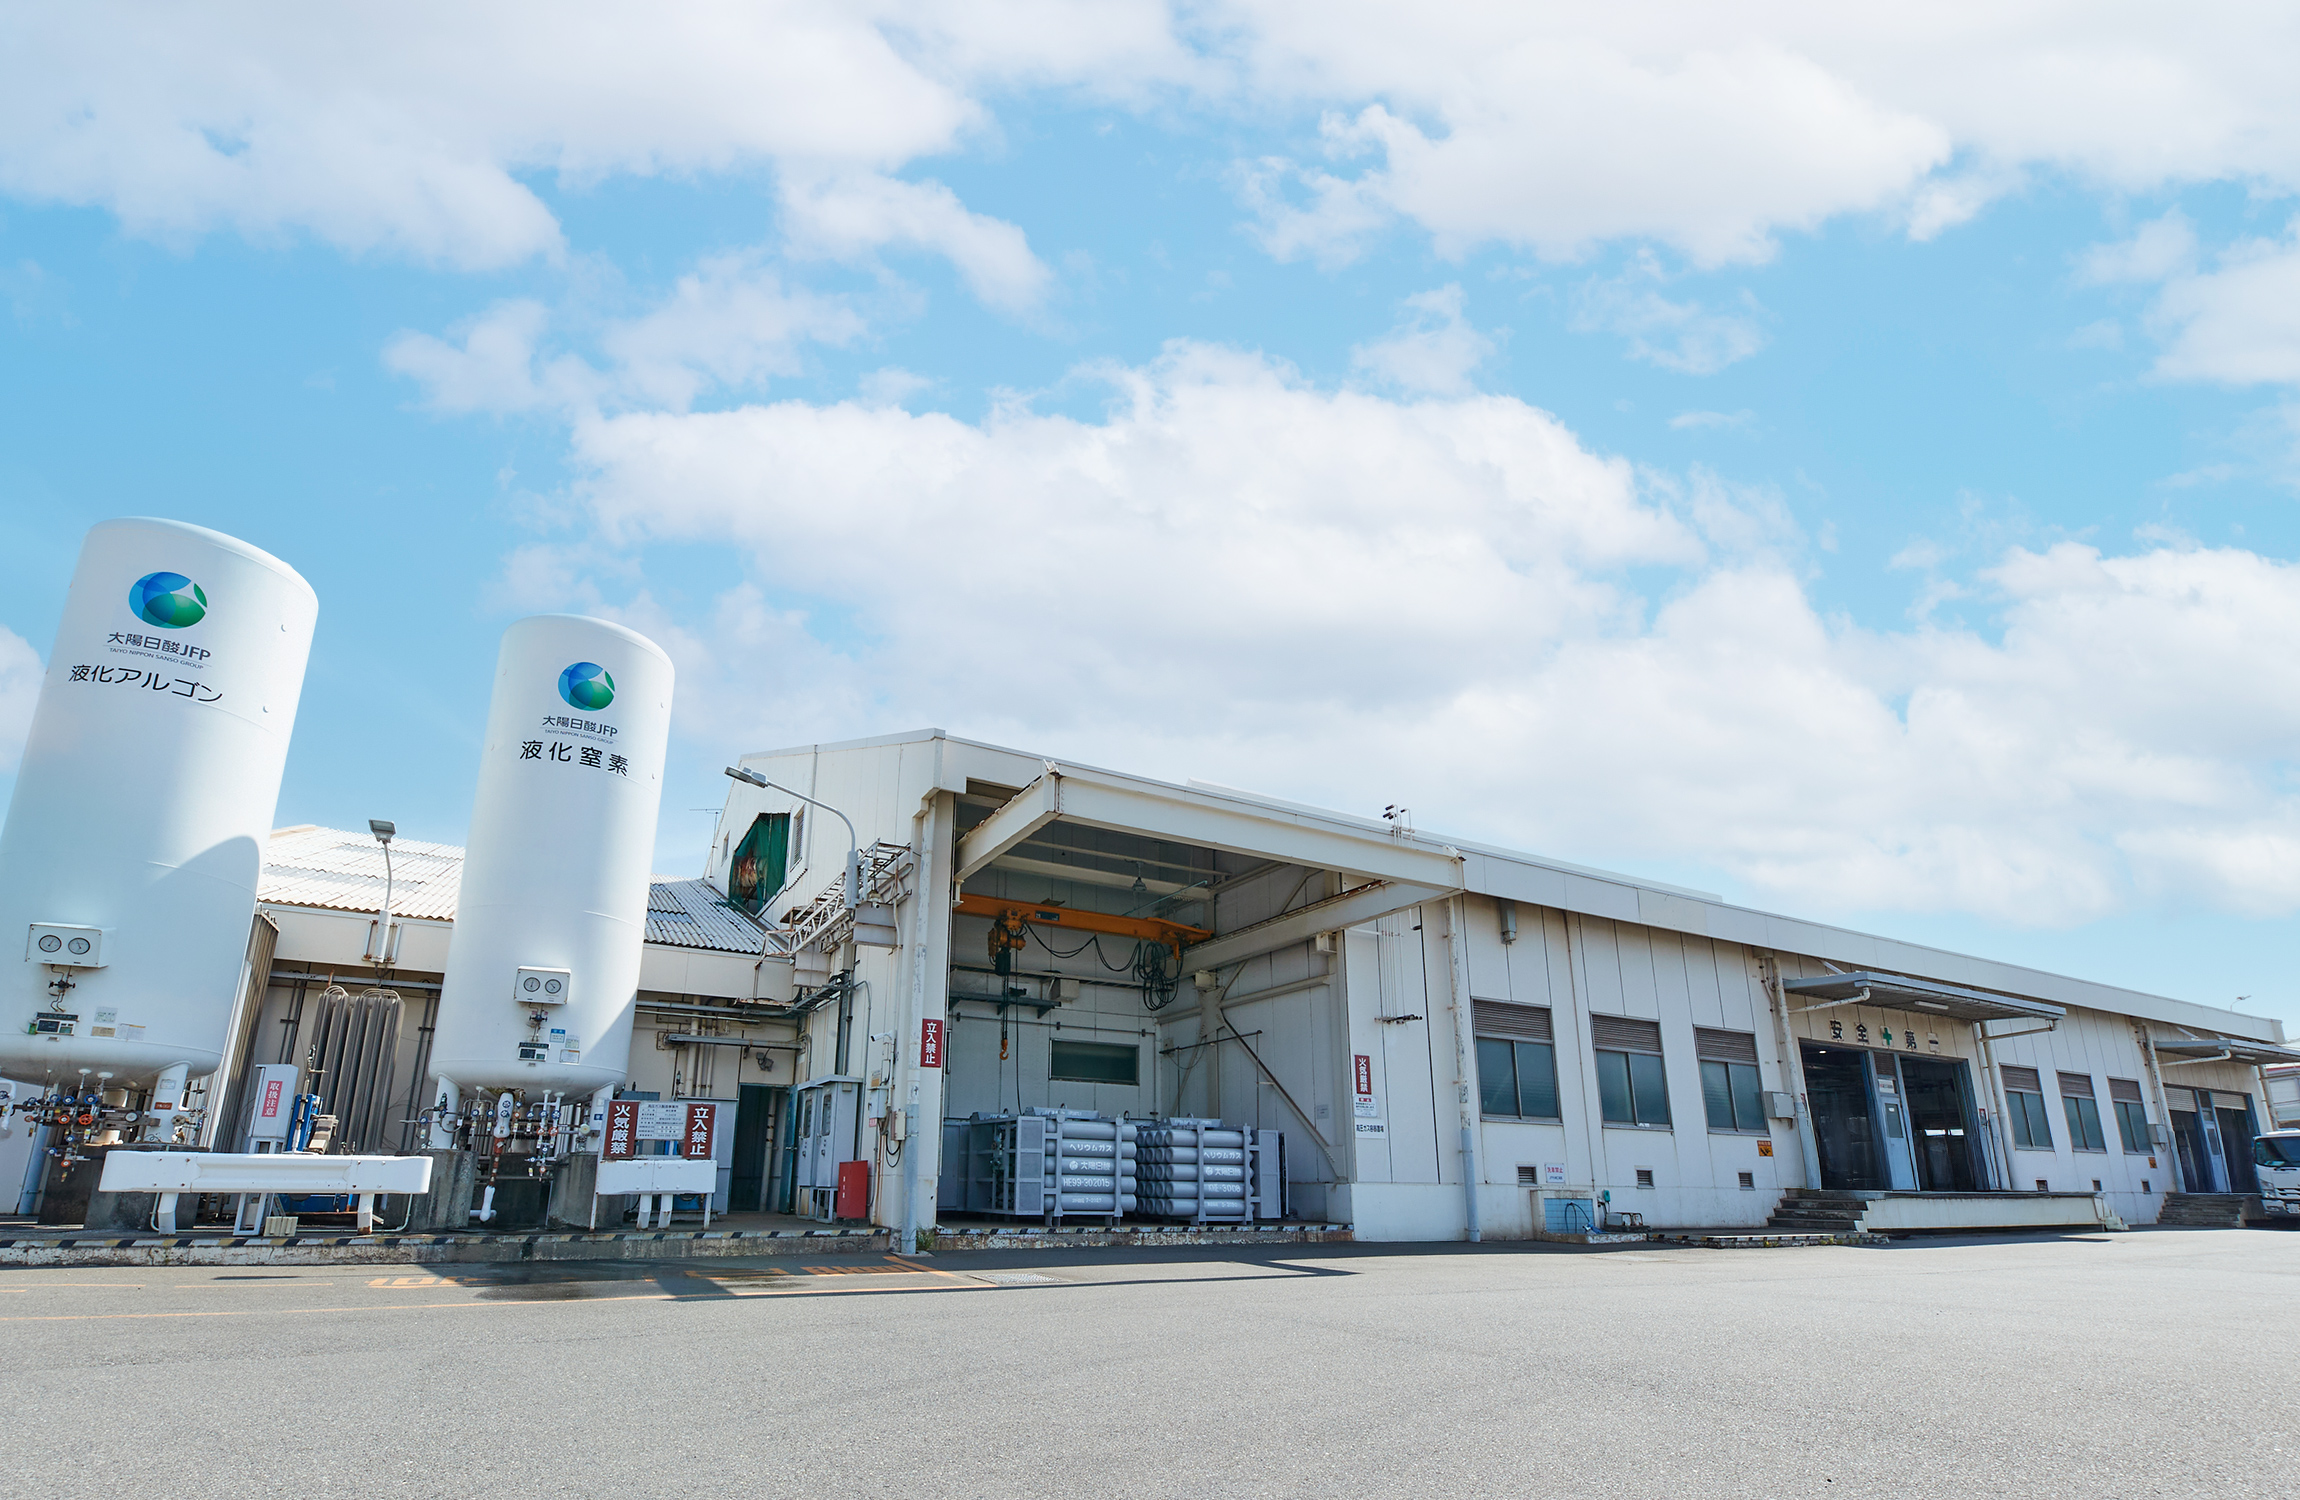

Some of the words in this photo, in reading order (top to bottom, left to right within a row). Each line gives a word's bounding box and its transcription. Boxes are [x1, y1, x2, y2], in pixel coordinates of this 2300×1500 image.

[107, 632, 211, 661] 大陽日酸JFP
[129, 650, 155, 658] NIPPON
[155, 654, 178, 664] SANSO
[180, 659, 204, 670] GROUP
[68, 664, 223, 702] 液化アルゴン
[542, 715, 618, 737] 大陽日酸JFP
[580, 733, 596, 741] SANSO
[597, 737, 614, 745] GROUP
[519, 739, 628, 777] 液化窒素
[925, 1021, 937, 1064] 立入禁止
[264, 1082, 280, 1116] 取扱注意
[610, 1104, 631, 1155] 火気厳禁
[690, 1106, 709, 1156] 立入禁止
[1069, 1143, 1113, 1152] ヘリウムガス
[1203, 1151, 1242, 1159] ヘリウムガス
